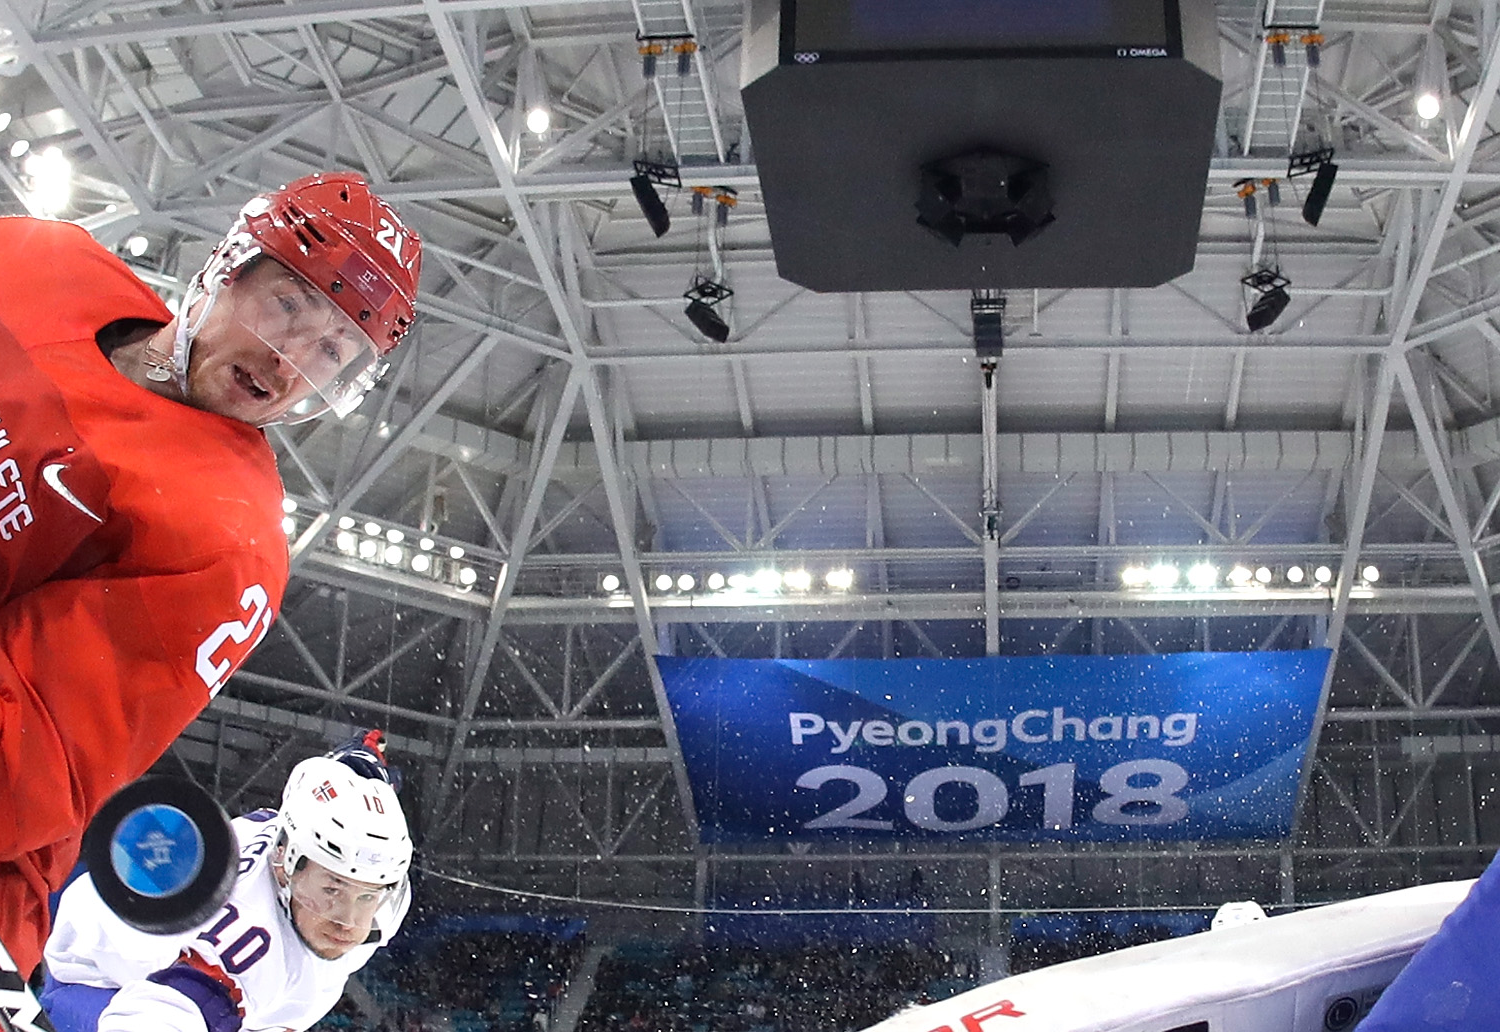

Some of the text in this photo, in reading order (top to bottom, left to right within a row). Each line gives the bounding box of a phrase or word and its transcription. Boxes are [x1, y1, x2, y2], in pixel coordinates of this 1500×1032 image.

[1129, 48, 1167, 57] OMEGA
[375, 217, 414, 269] 21
[787, 706, 1199, 754] PyeongChang
[362, 793, 385, 815] 10
[795, 757, 1190, 831] 2018
[196, 903, 272, 975] 10
